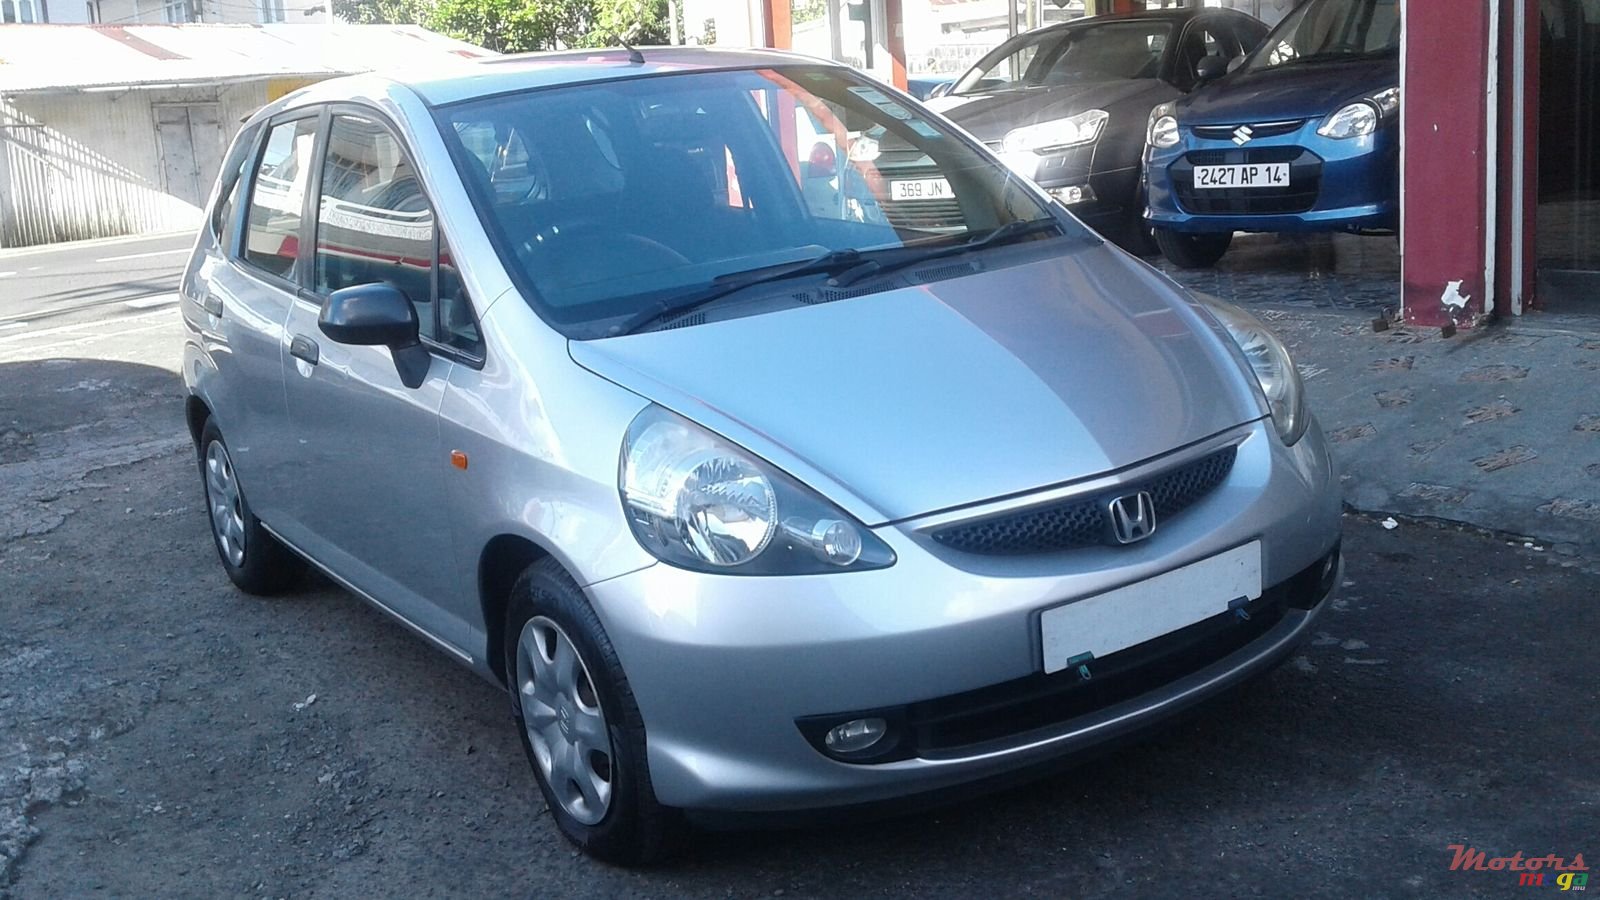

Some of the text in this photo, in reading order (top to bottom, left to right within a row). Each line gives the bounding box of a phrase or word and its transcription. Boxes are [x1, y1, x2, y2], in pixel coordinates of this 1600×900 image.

[1201, 166, 1282, 185] 2427 AP 14
[900, 182, 942, 197] 369 JN
